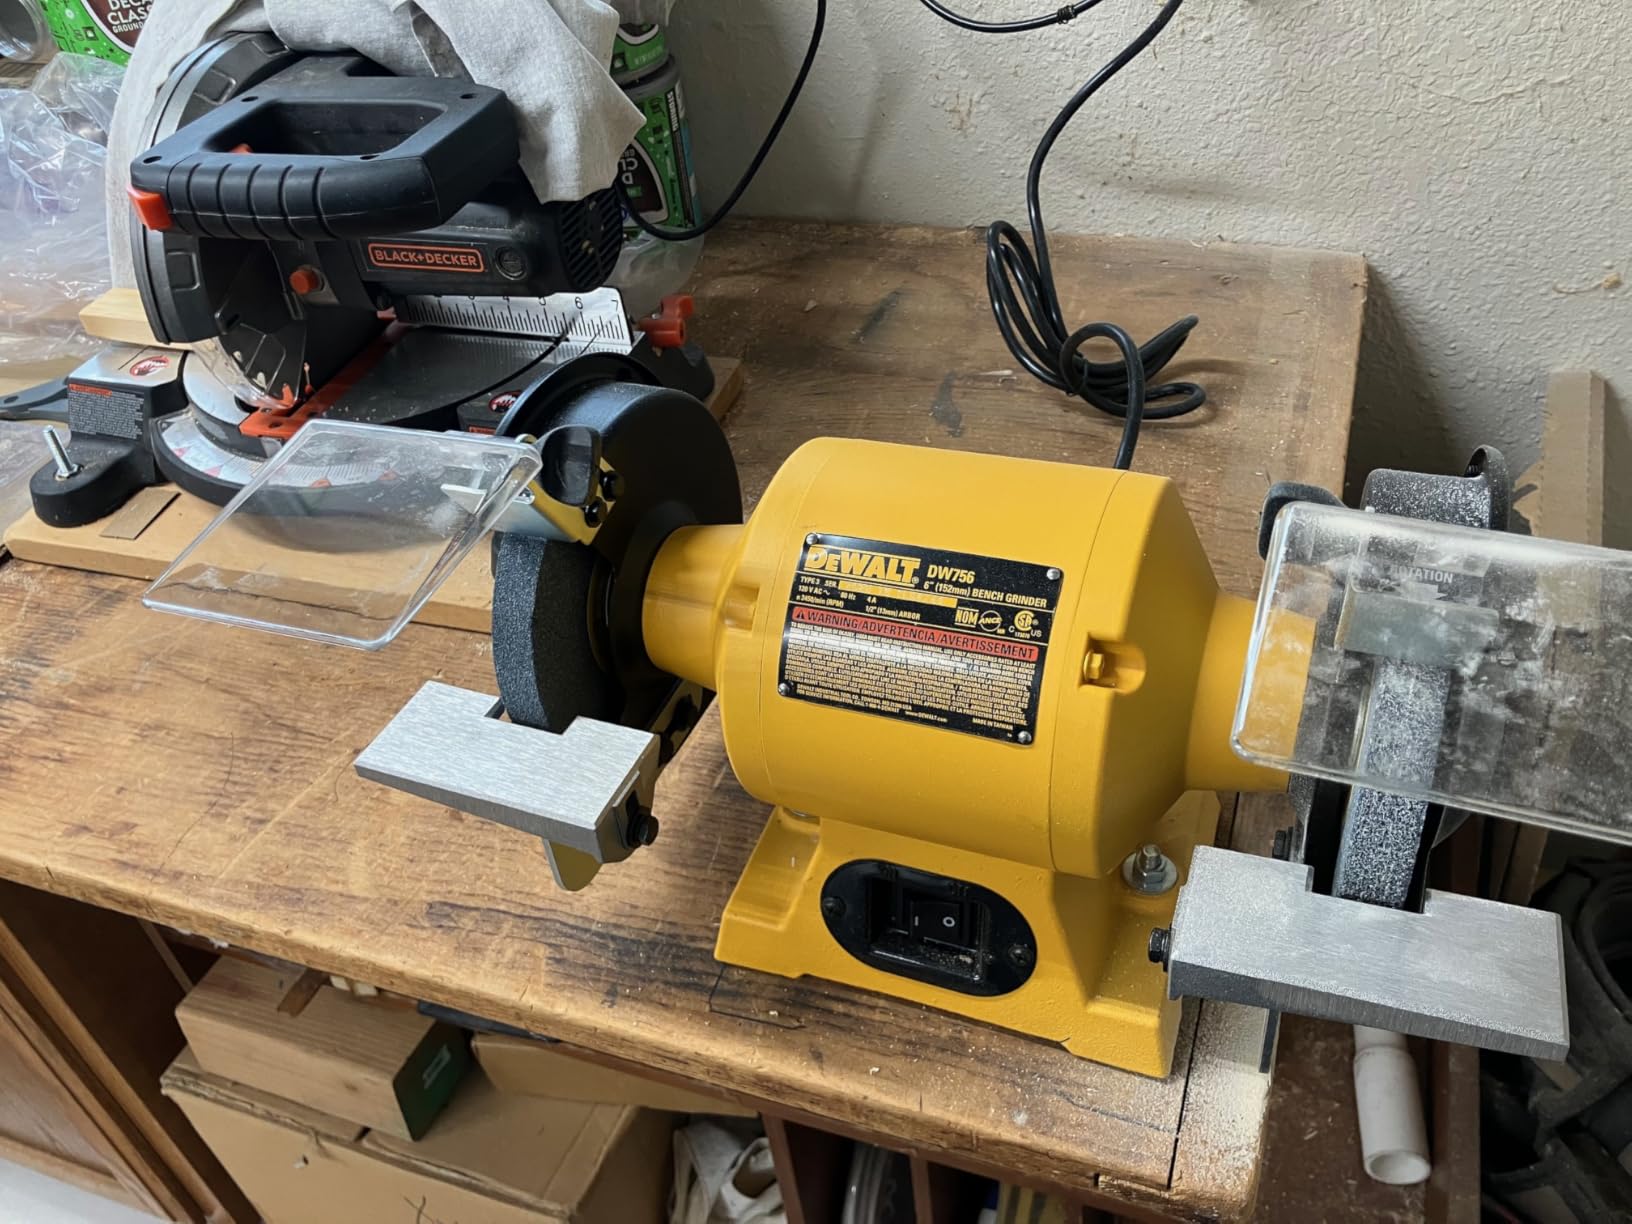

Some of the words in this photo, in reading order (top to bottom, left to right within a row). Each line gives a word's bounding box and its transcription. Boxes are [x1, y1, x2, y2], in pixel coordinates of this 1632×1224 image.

[375, 250, 478, 267] BLACK+DECKER
[575, 296, 583, 309] 6
[800, 575, 815, 584] TYPE
[927, 564, 976, 584] DW756
[935, 583, 970, 597] (152mm)
[972, 588, 1004, 601] BENCH
[1005, 593, 1047, 608] GRINDER
[955, 609, 979, 625] NOM
